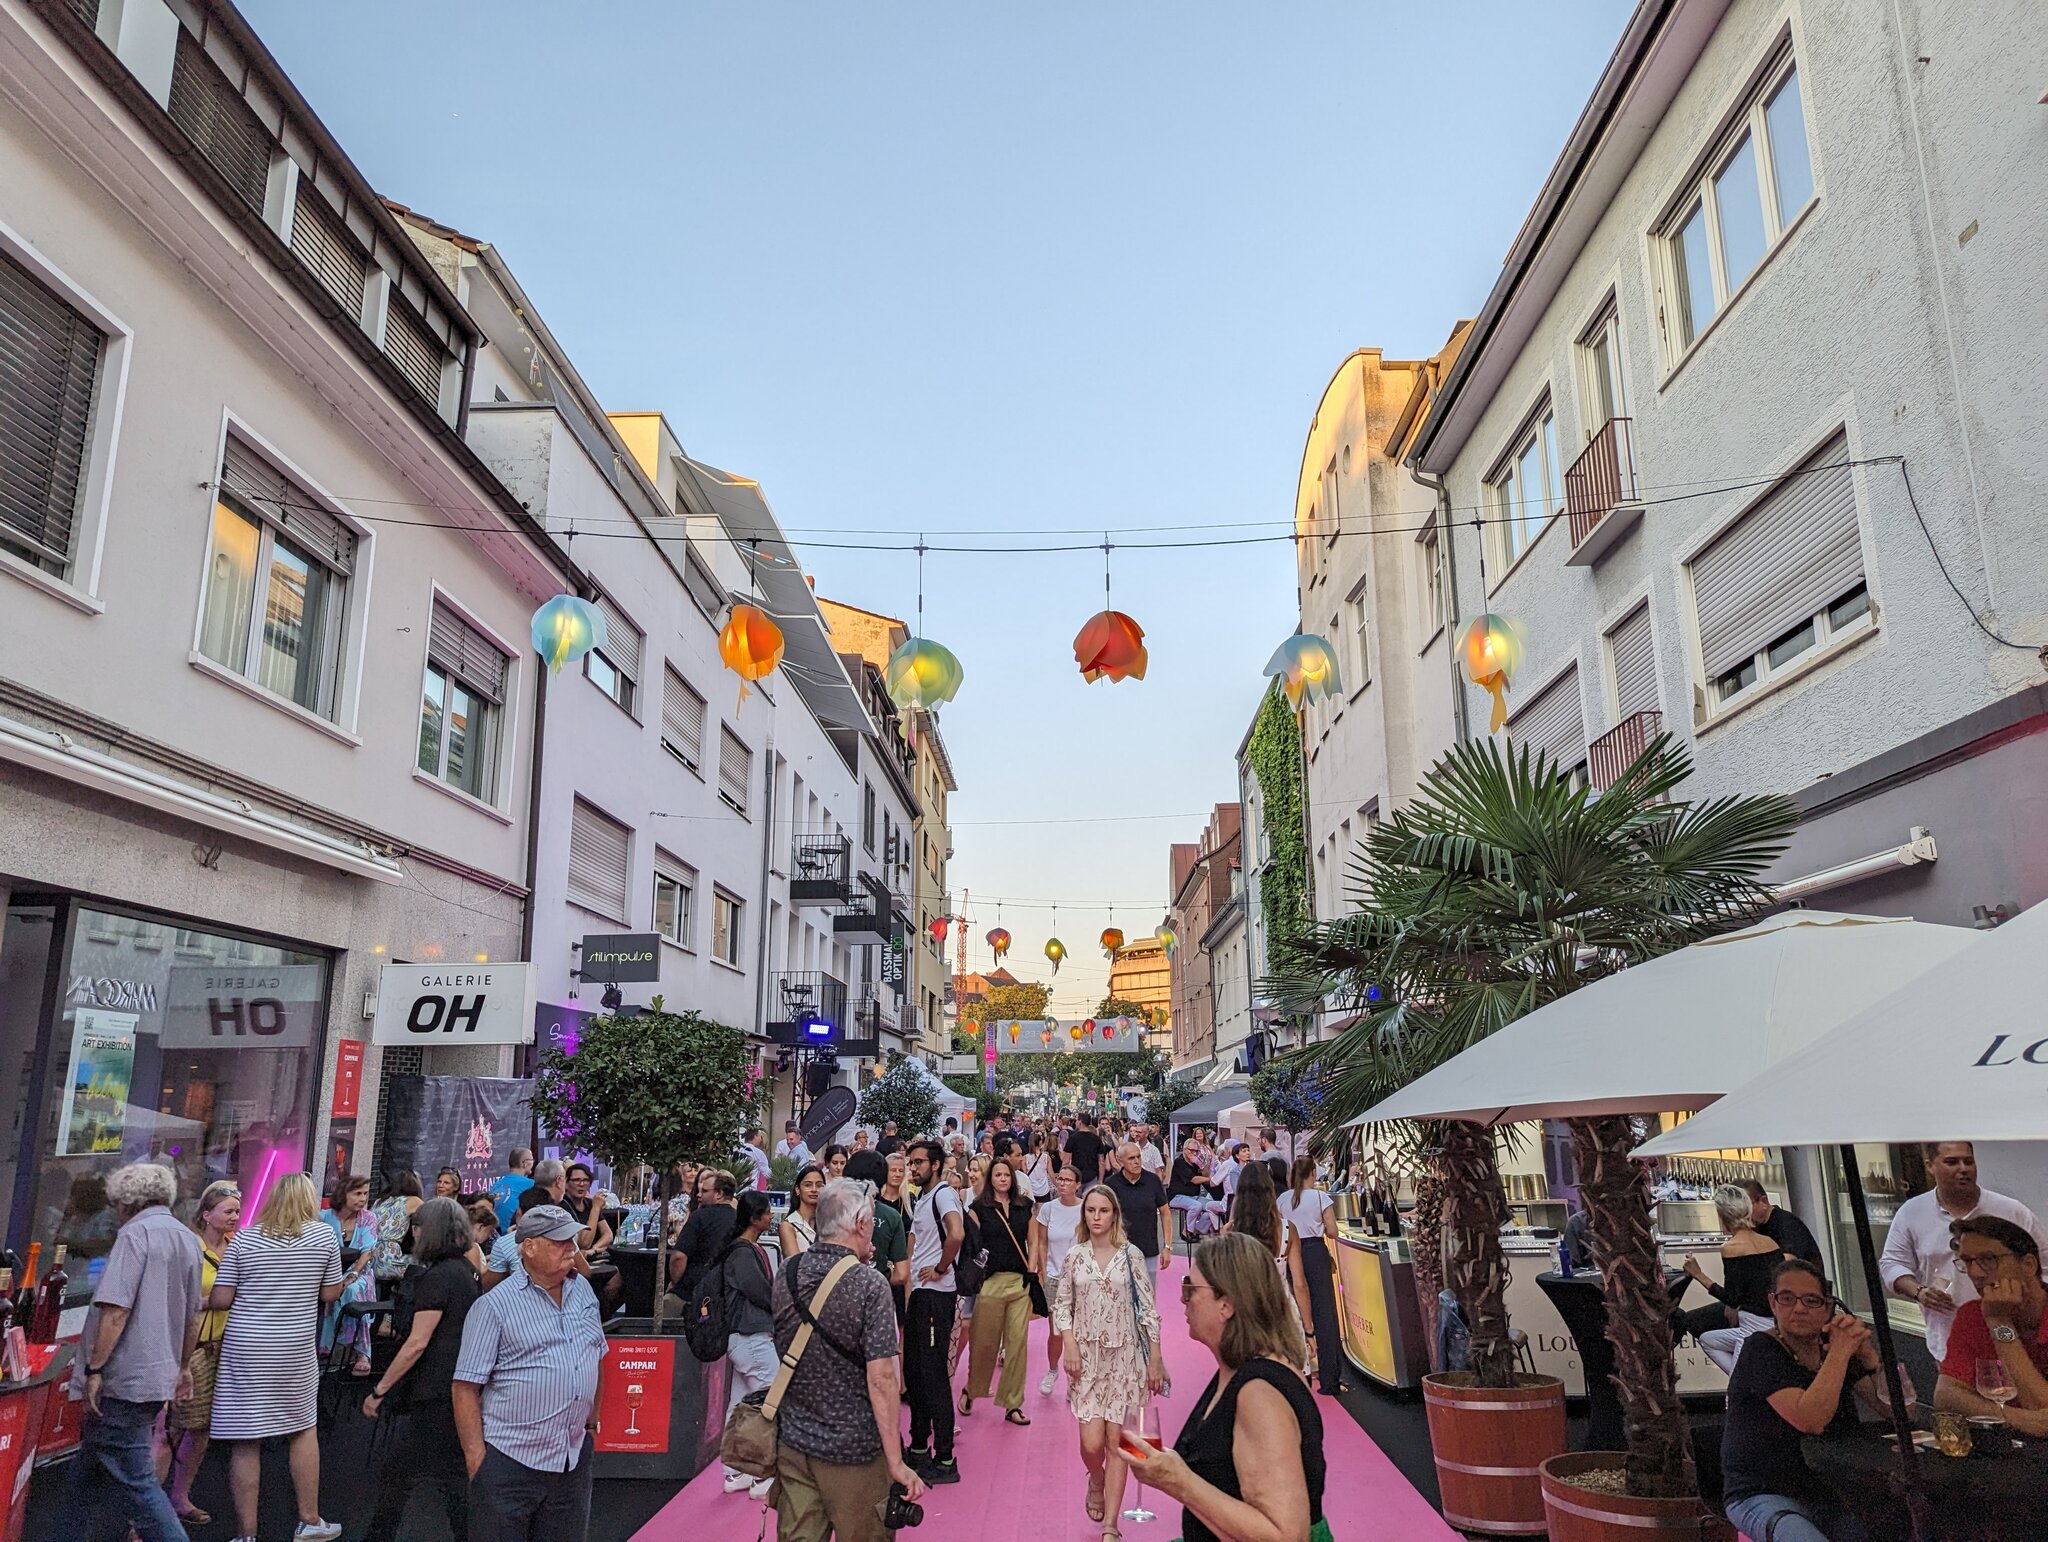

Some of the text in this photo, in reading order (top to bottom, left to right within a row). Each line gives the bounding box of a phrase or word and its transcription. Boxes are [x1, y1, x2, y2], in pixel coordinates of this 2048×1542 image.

[883, 934, 893, 983] BASSMA
[893, 953, 903, 980] OPTIK
[421, 975, 492, 987] GALERIE
[406, 994, 487, 1033] OH
[81, 1039, 133, 1051] ART EXHIBITION
[477, 1176, 505, 1193] SANT
[1538, 1333, 1579, 1352] LOU
[619, 1361, 657, 1370] CAMPARI
